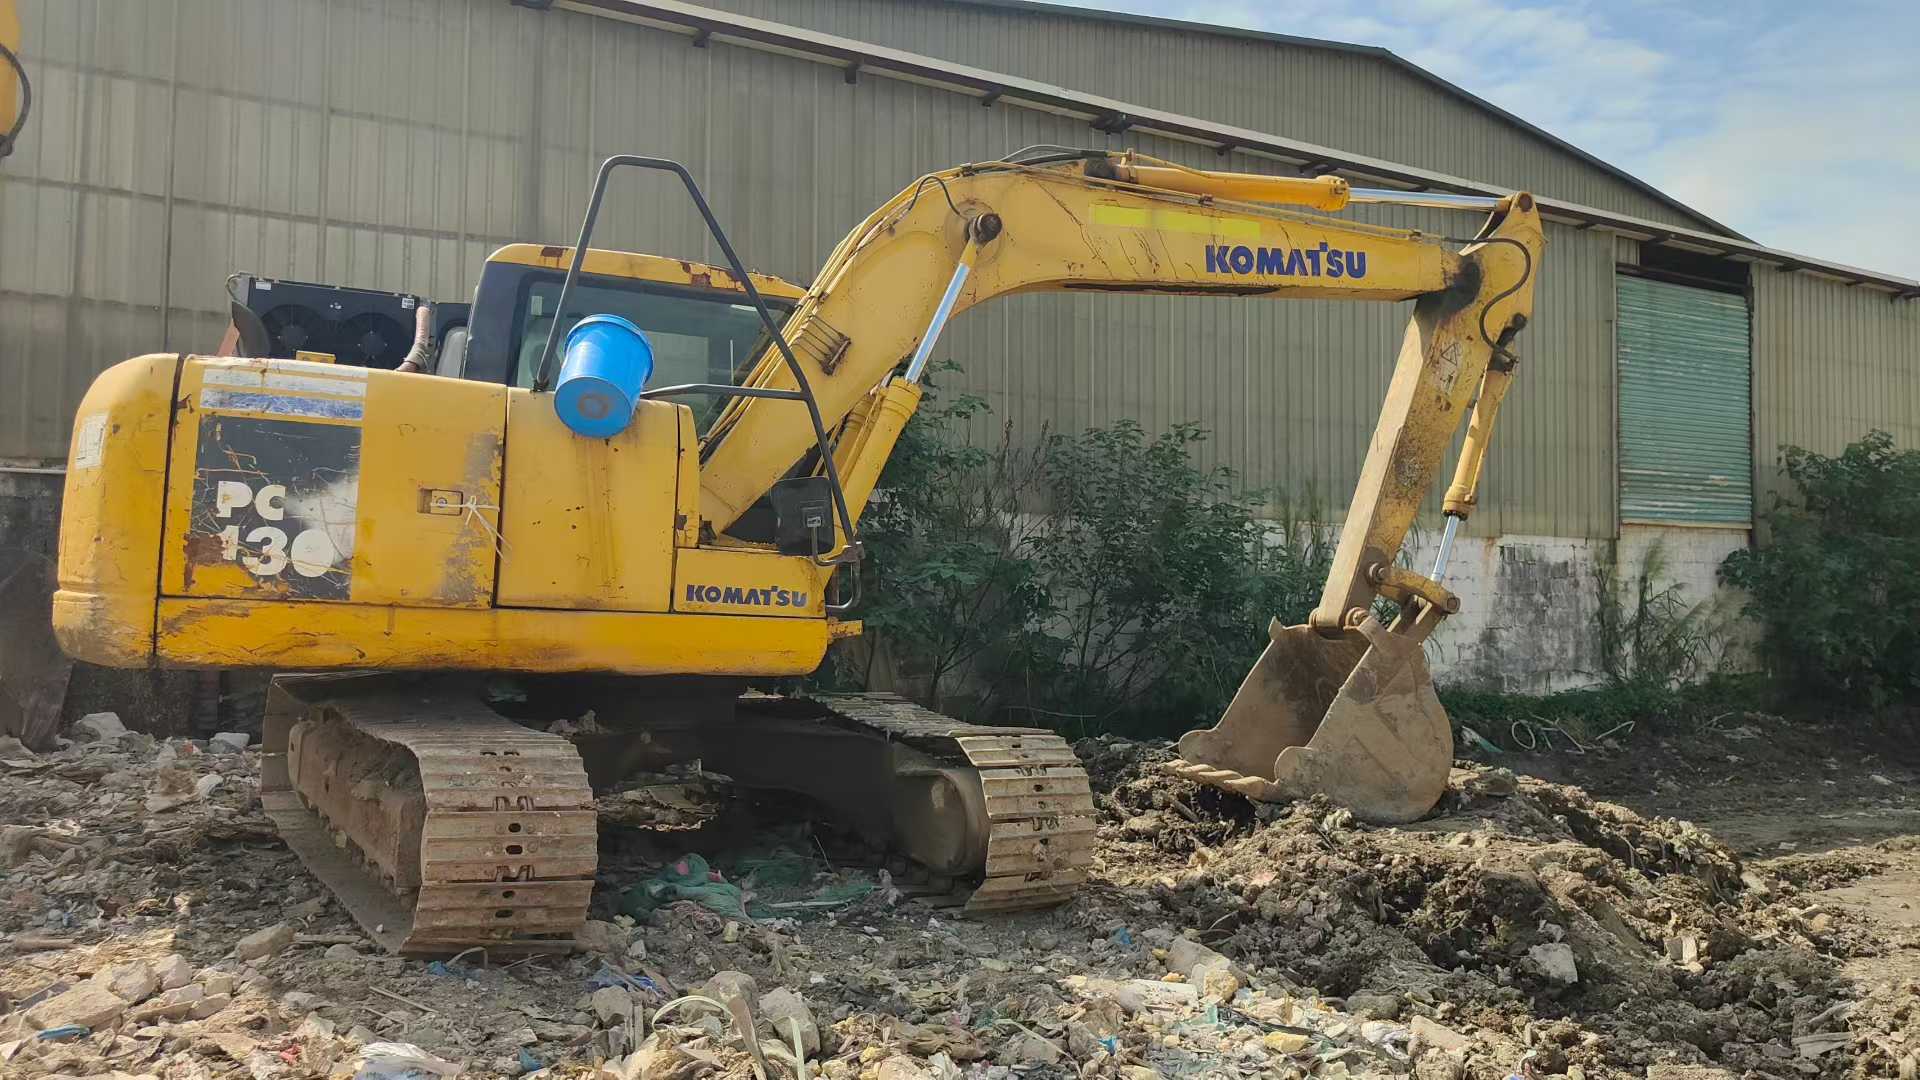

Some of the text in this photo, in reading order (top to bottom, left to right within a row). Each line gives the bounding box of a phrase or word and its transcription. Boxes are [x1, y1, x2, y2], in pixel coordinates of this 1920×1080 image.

[1205, 242, 1366, 278] KOMATSU
[216, 481, 286, 520] PC
[216, 525, 334, 577] 130
[686, 584, 807, 607] KOMATSU
